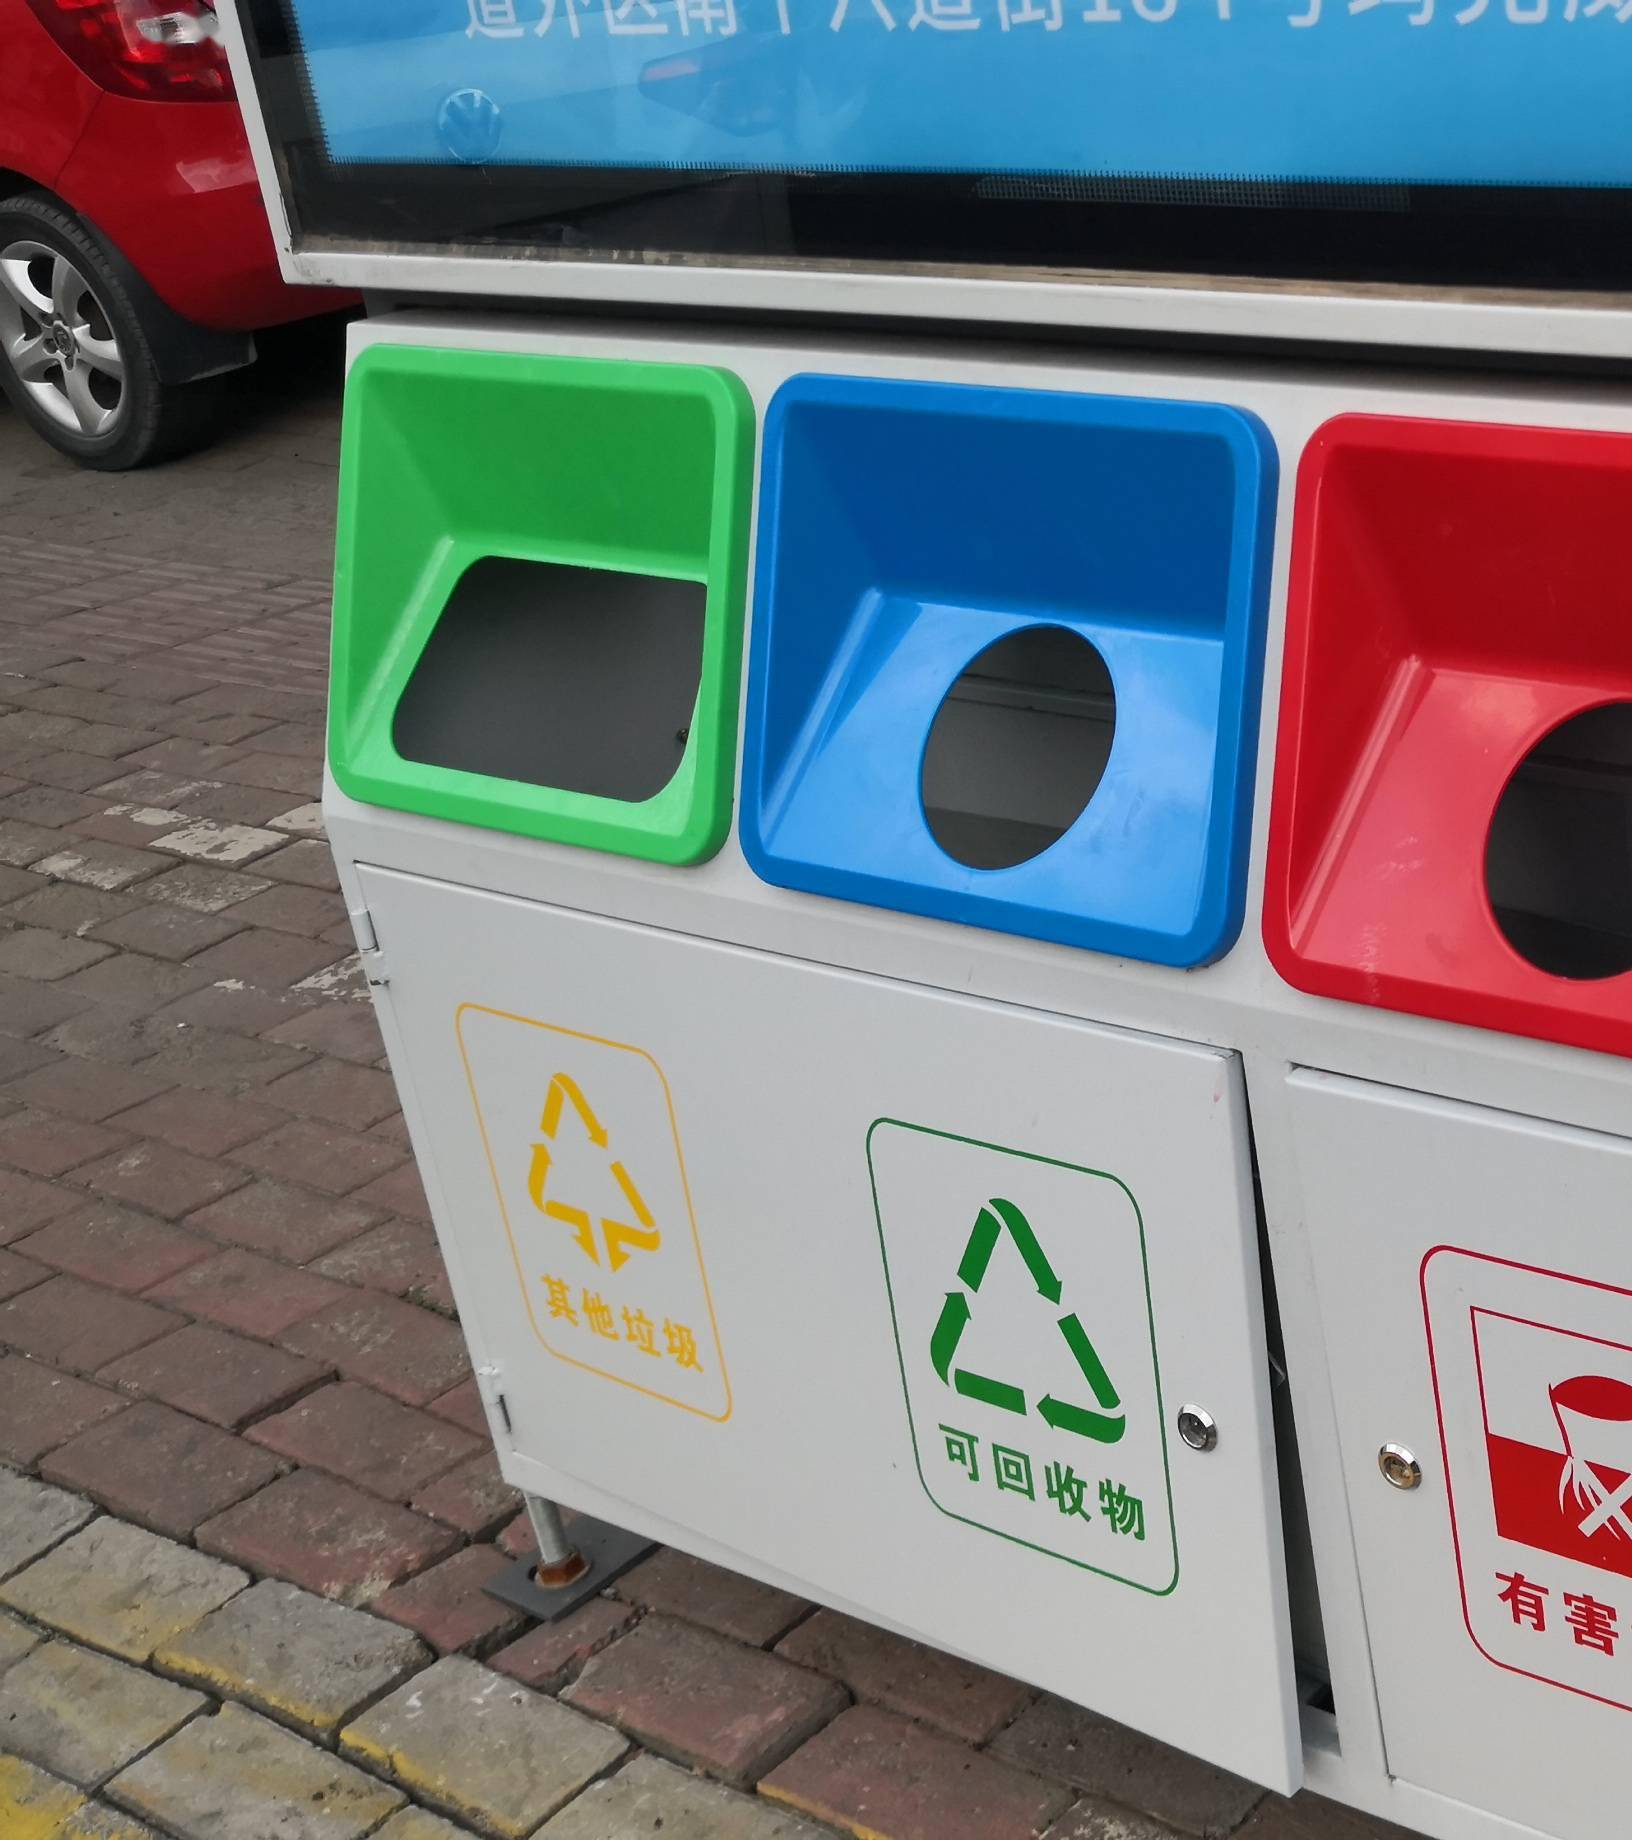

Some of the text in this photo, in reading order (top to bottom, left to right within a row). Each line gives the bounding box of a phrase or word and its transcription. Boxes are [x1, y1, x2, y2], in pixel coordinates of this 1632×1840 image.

[540, 1273, 705, 1374] 其他垃圾
[939, 1424, 1146, 1541] 可回收物
